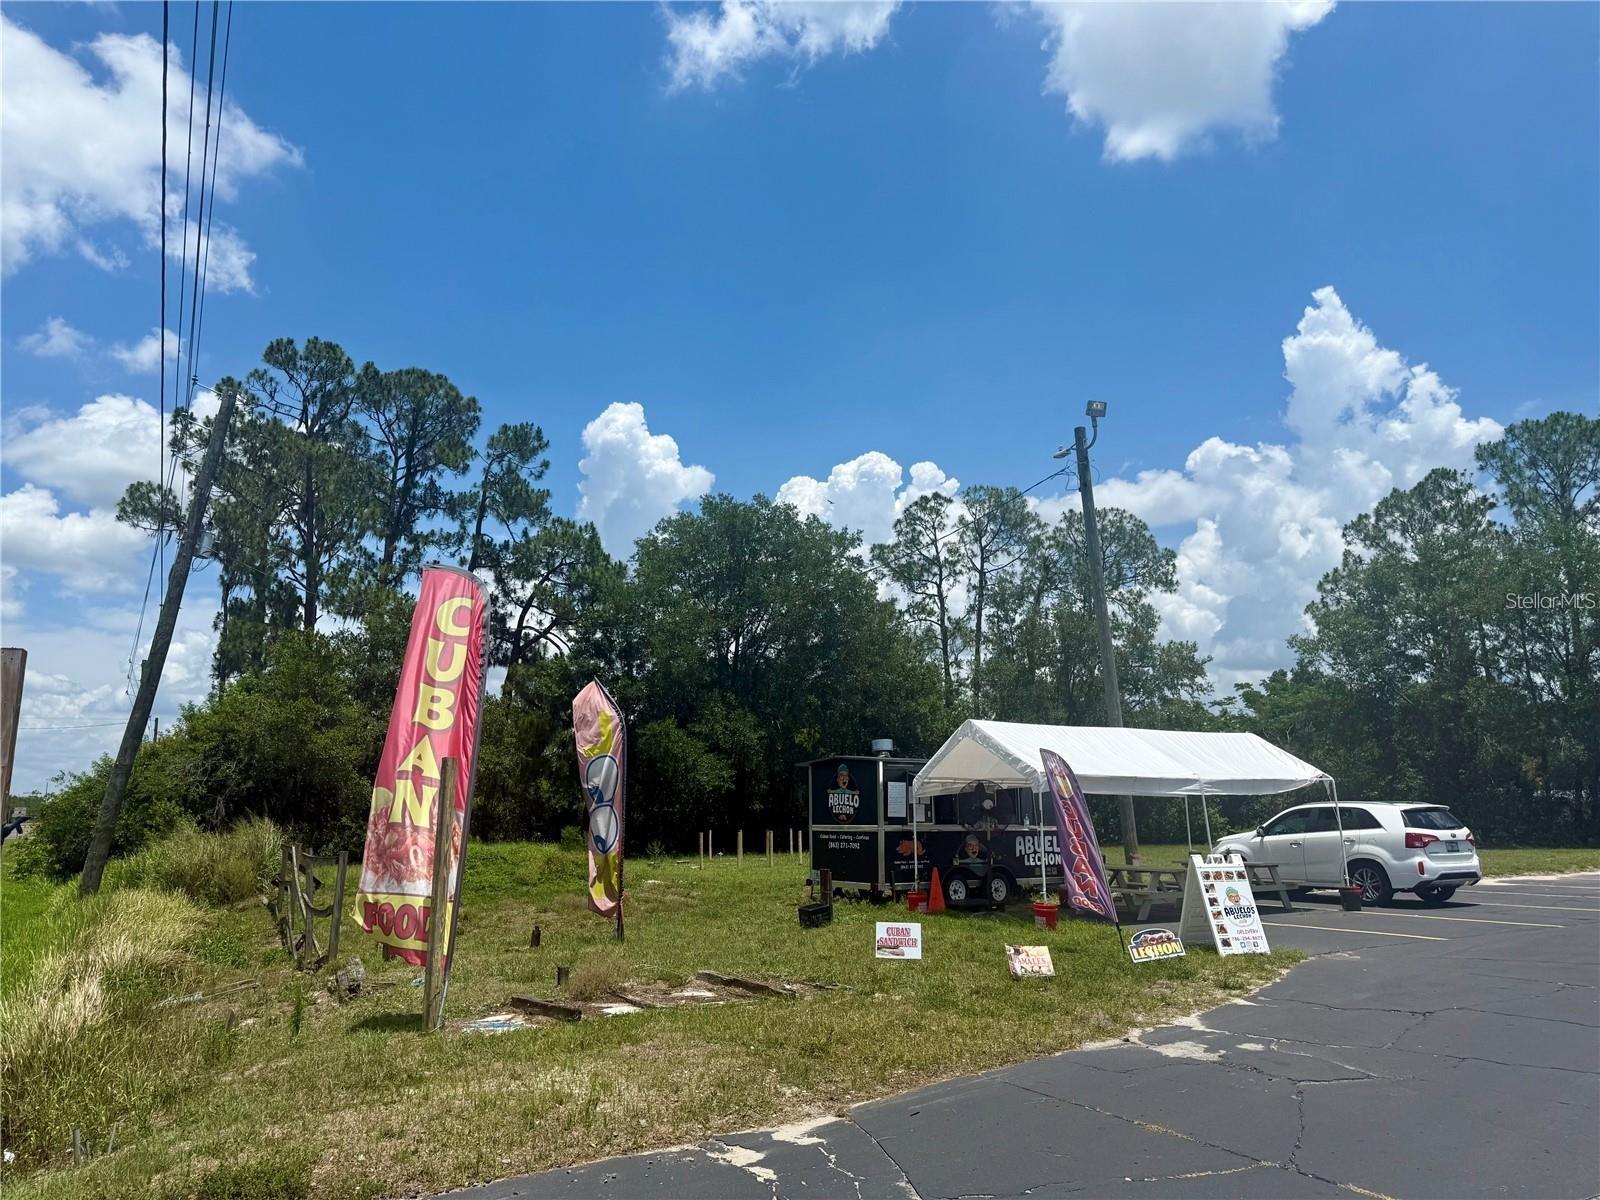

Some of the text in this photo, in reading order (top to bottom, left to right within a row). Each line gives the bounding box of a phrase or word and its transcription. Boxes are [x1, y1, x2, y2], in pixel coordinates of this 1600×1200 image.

[388, 596, 474, 829] CUBAN
[829, 793, 859, 808] ABUELO
[833, 805, 853, 814] LECHON
[1015, 835, 1061, 857] ABUEL
[1024, 852, 1062, 866] LECHON
[1223, 906, 1256, 917] ABUELOS
[886, 926, 911, 937] CUBAN
[879, 937, 918, 948] SANDWICH
[1132, 941, 1182, 959] LECHON
